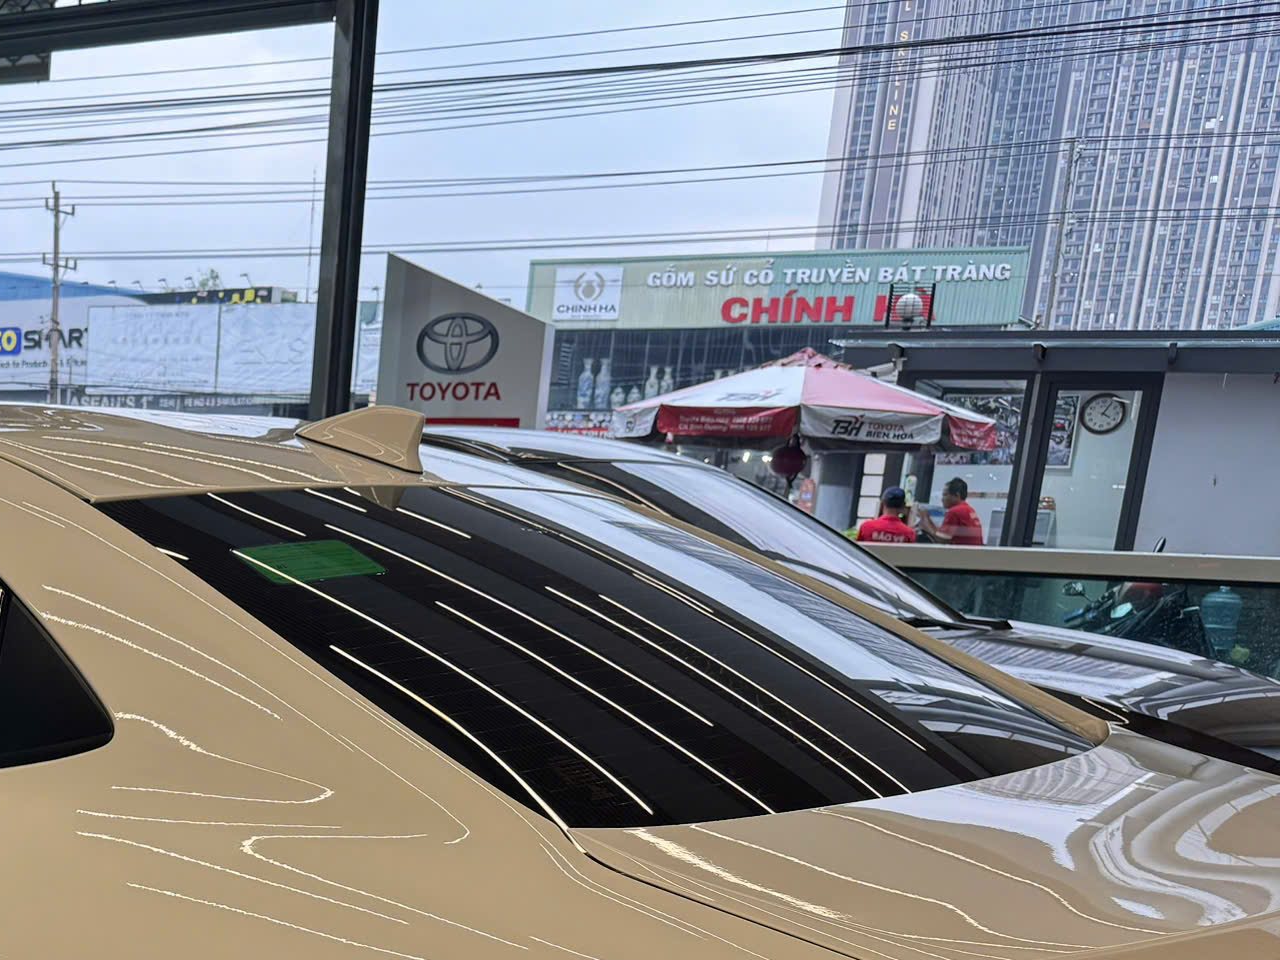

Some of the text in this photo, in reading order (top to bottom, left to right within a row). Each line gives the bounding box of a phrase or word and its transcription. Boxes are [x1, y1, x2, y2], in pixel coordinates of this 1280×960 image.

[647, 264, 695, 288] GỐM
[704, 264, 738, 287] SỨ
[783, 259, 870, 286] TRUYỀN
[877, 259, 926, 284] BÁT
[933, 260, 1011, 283] TRÀNG
[721, 289, 855, 324] CHÍNH
[23, 328, 87, 350] SMAR
[407, 382, 502, 401] TOYOTA
[868, 422, 905, 432] TOYOTA
